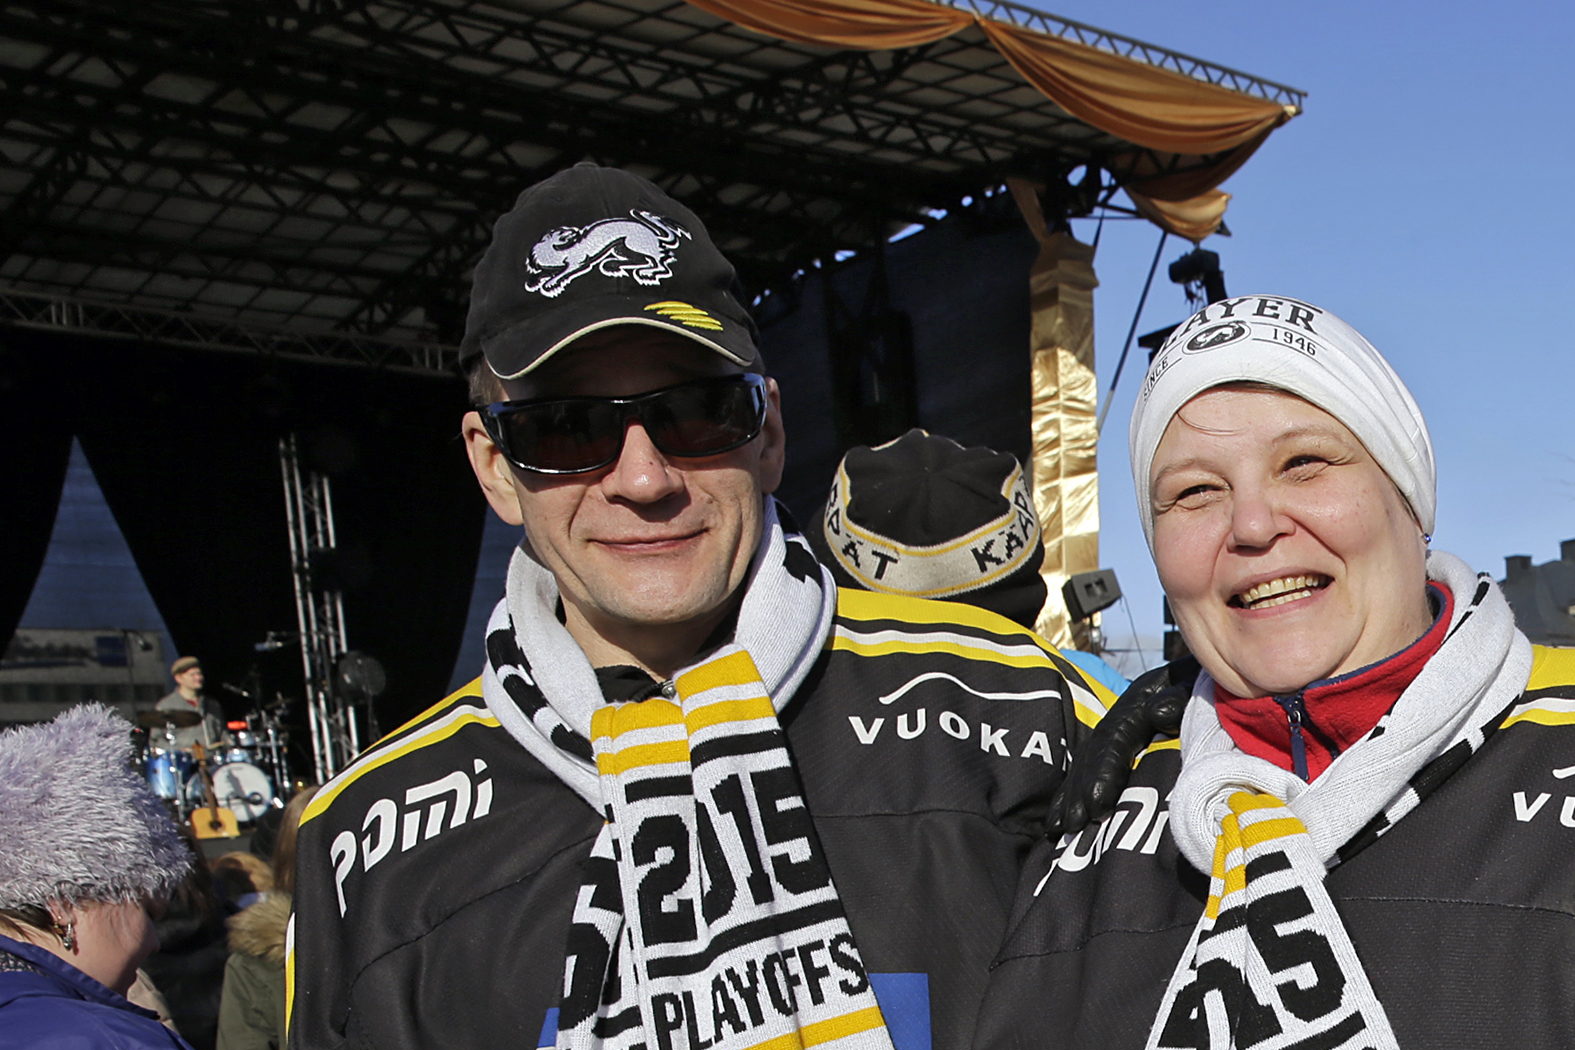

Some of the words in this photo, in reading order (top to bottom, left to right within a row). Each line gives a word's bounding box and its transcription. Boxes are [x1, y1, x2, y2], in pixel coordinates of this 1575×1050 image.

[1156, 297, 1319, 360] LAYER
[1271, 328, 1317, 356] 1946
[847, 708, 1068, 768] VUOKA
